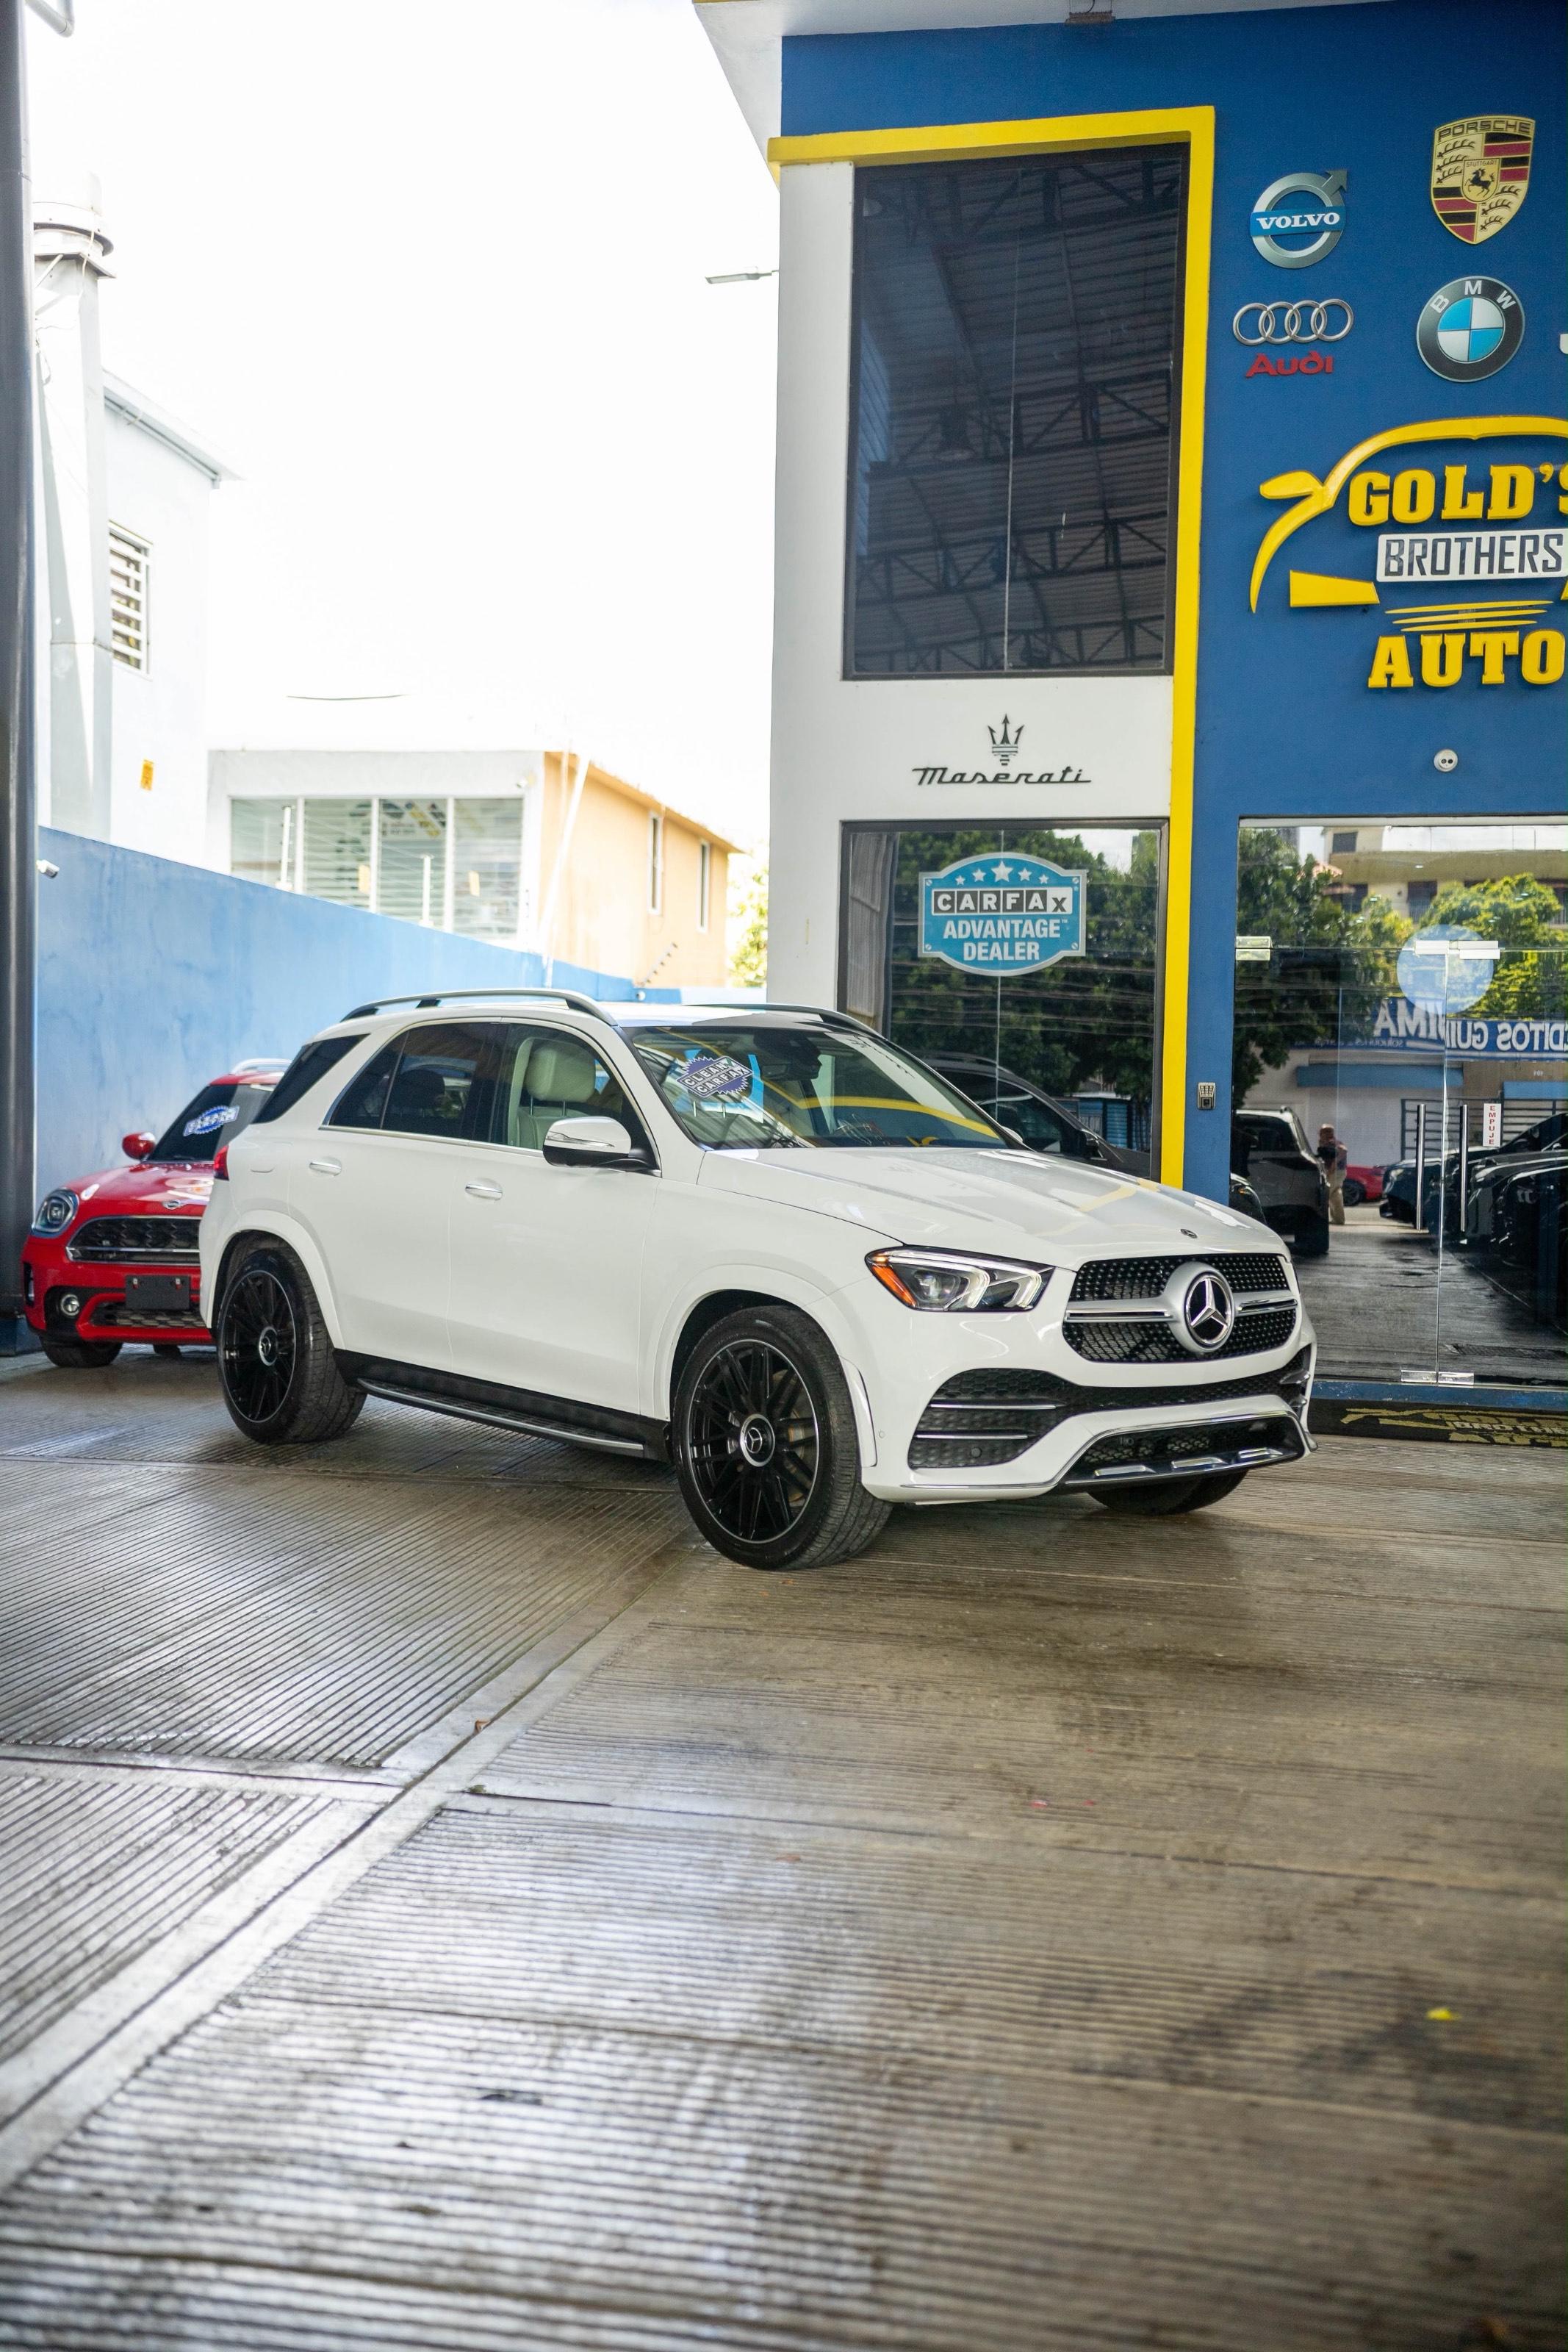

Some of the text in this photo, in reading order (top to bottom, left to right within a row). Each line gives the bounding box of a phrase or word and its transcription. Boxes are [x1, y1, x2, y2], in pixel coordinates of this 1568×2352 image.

[1438, 120, 1531, 143] PORSCHE
[1466, 159, 1497, 168] STUTTGART
[1256, 212, 1340, 231] VOLVO
[1431, 280, 1517, 315] BMW
[1245, 351, 1334, 379] Audi
[1348, 462, 1568, 526] GOLD'
[1384, 534, 1563, 577] BROTHERS
[1368, 629, 1565, 688] AUTO
[912, 766, 1092, 786] Maserati
[937, 892, 1067, 913] CARFAX
[943, 919, 1061, 939] ADVANTAGE
[963, 942, 1040, 961] DEALER
[684, 1062, 729, 1086] CLEAN
[697, 1068, 748, 1093] CARFAX
[1488, 1105, 1496, 1145] EMPUJE
